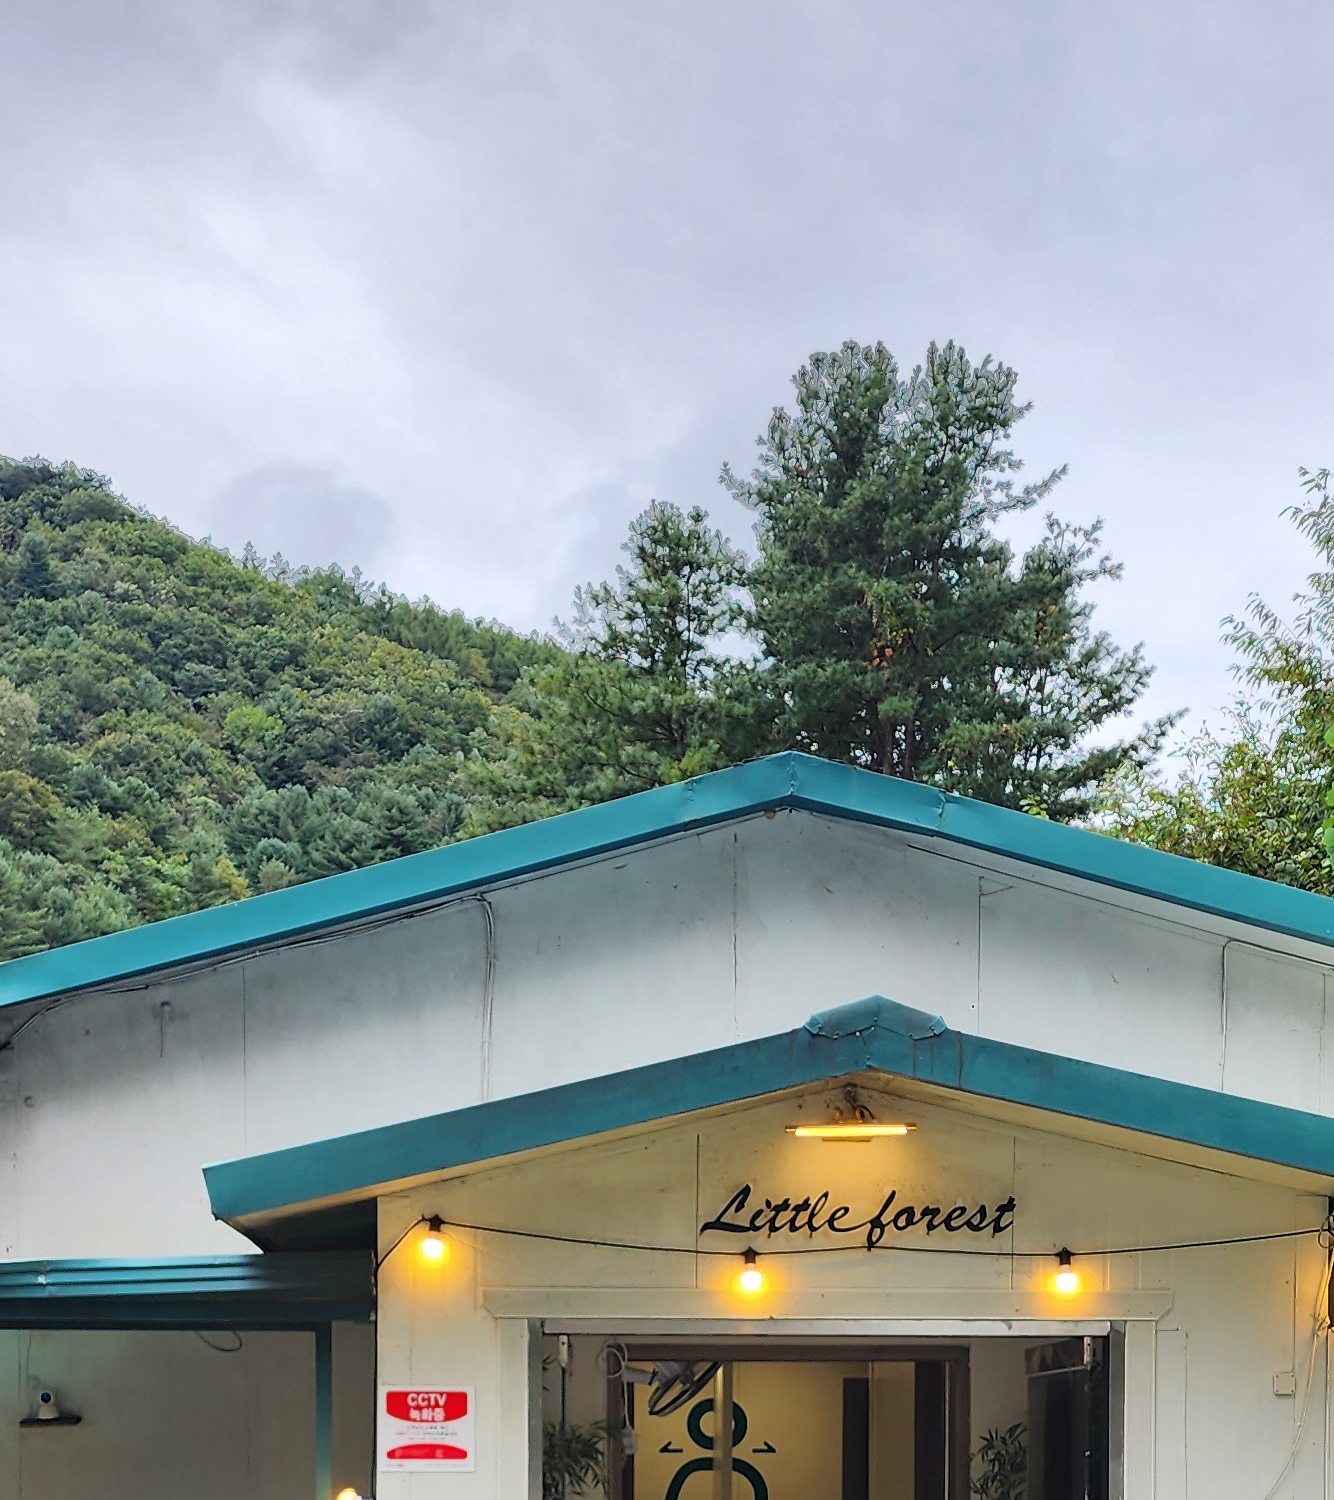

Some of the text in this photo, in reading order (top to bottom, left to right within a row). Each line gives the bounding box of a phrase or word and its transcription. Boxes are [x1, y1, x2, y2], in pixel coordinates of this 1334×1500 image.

[700, 1184, 1016, 1251] Little forest
[407, 1393, 447, 1406] CCTV
[409, 1407, 446, 1421] 녹화중
